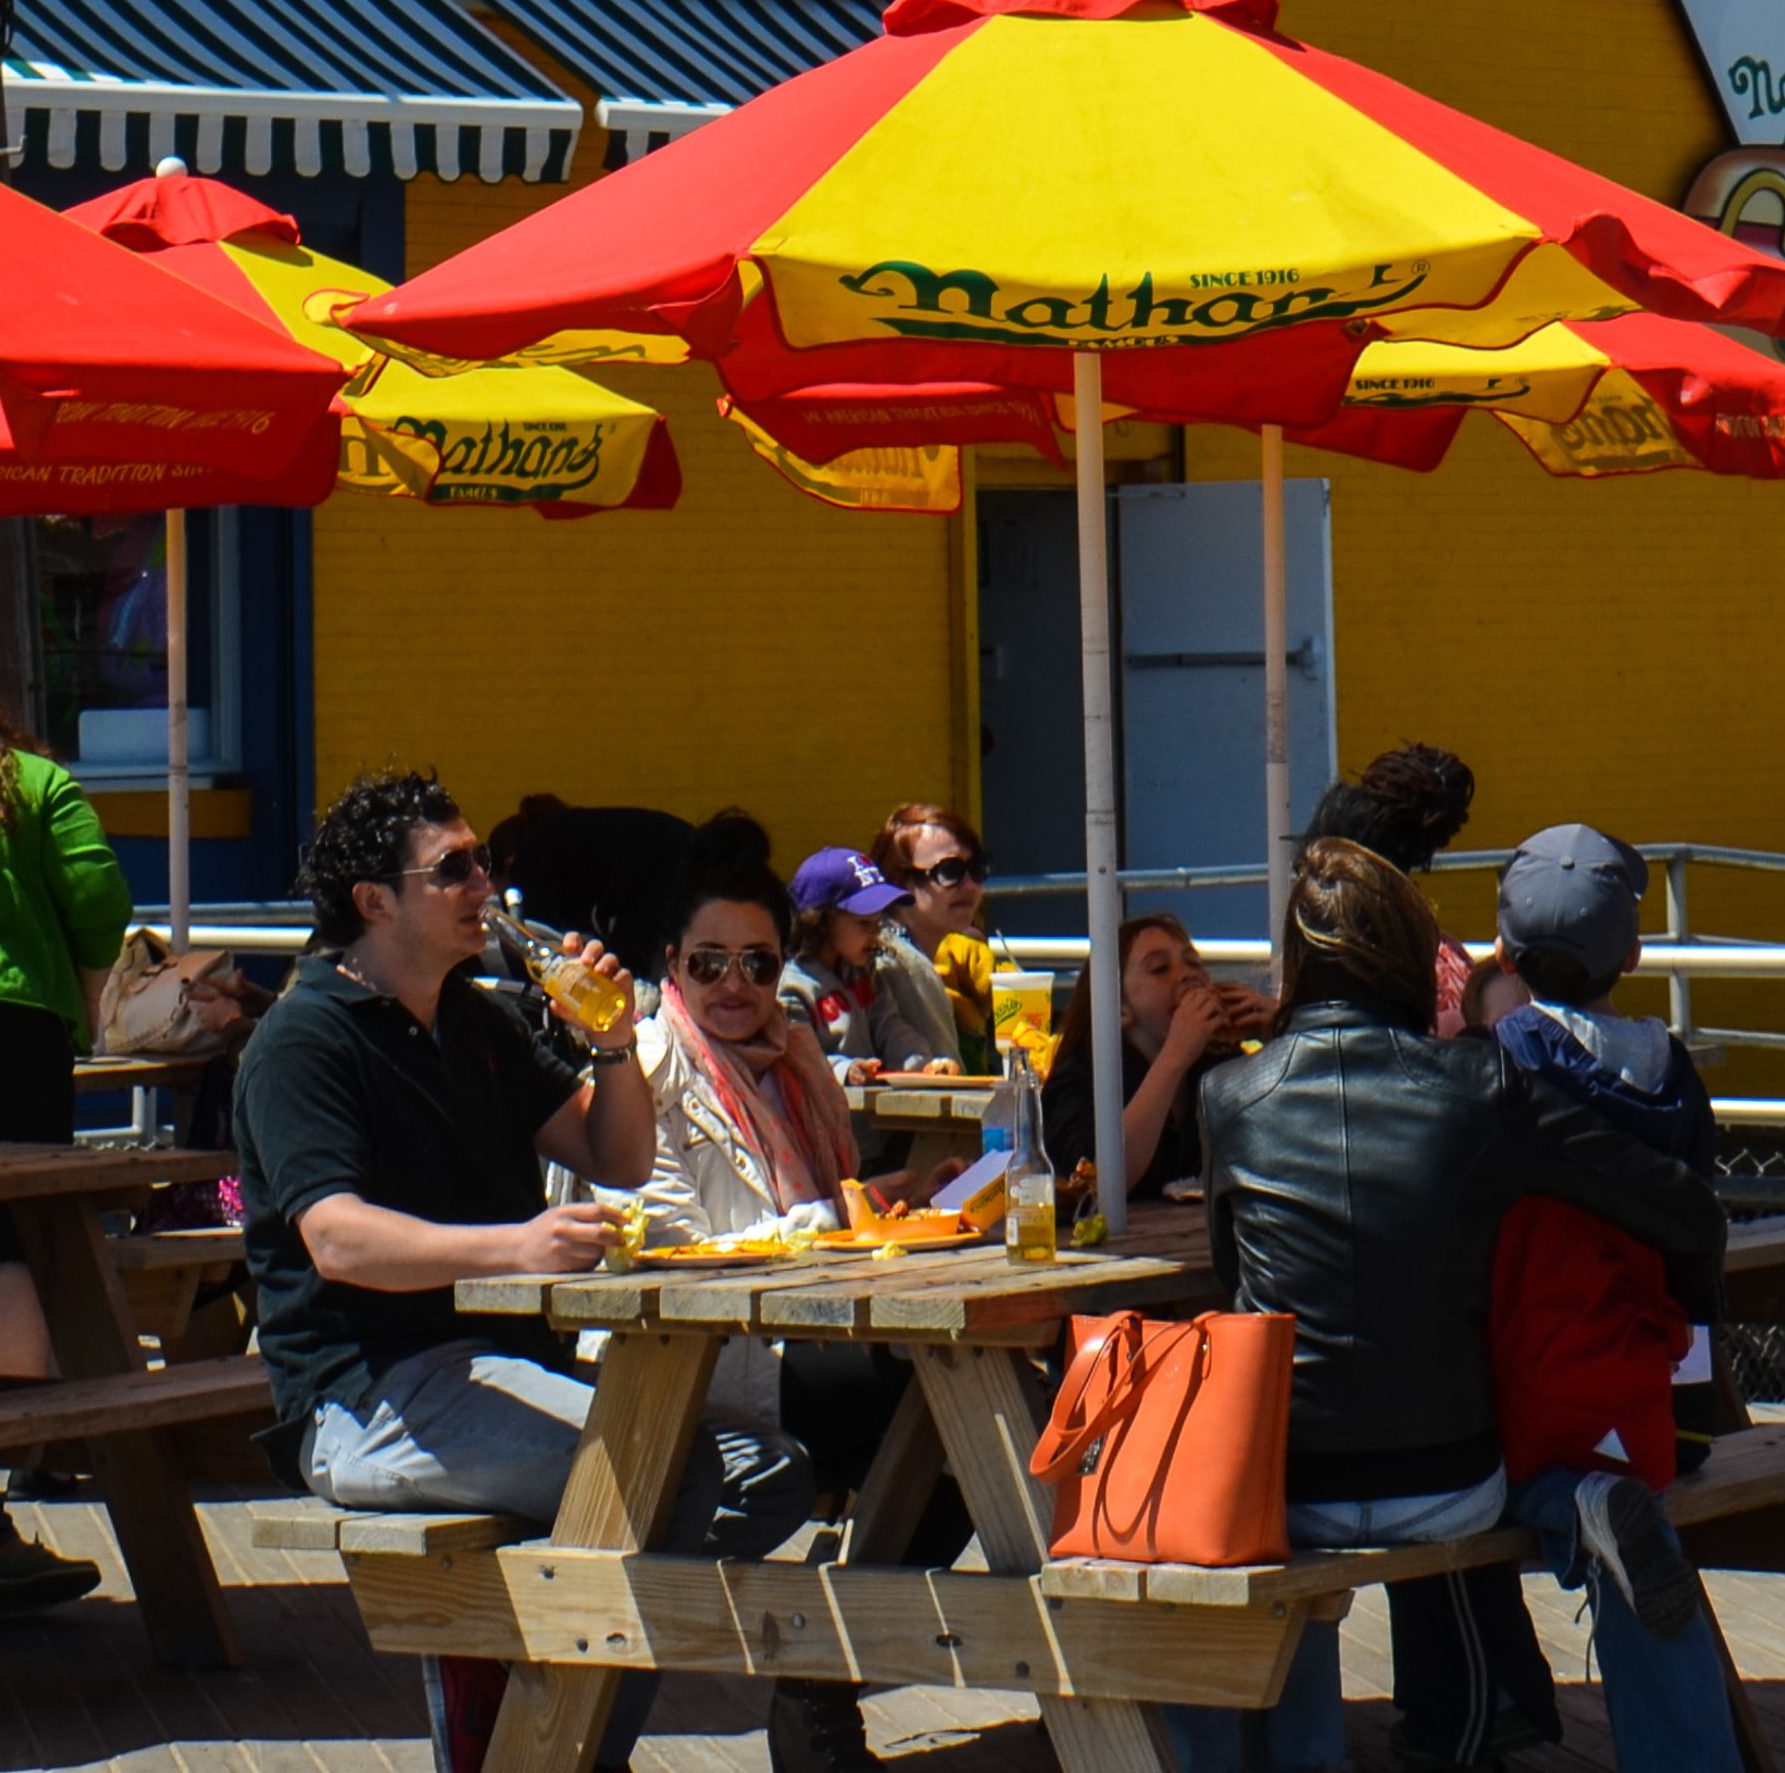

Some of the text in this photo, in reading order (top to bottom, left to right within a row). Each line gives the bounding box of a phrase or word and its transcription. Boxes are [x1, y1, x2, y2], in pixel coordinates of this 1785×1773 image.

[1189, 267, 1301, 289] SINCE 1916
[1355, 376, 1436, 391] SINCE 1916
[59, 462, 166, 486] TRADITION
[854, 866, 885, 888] NY
